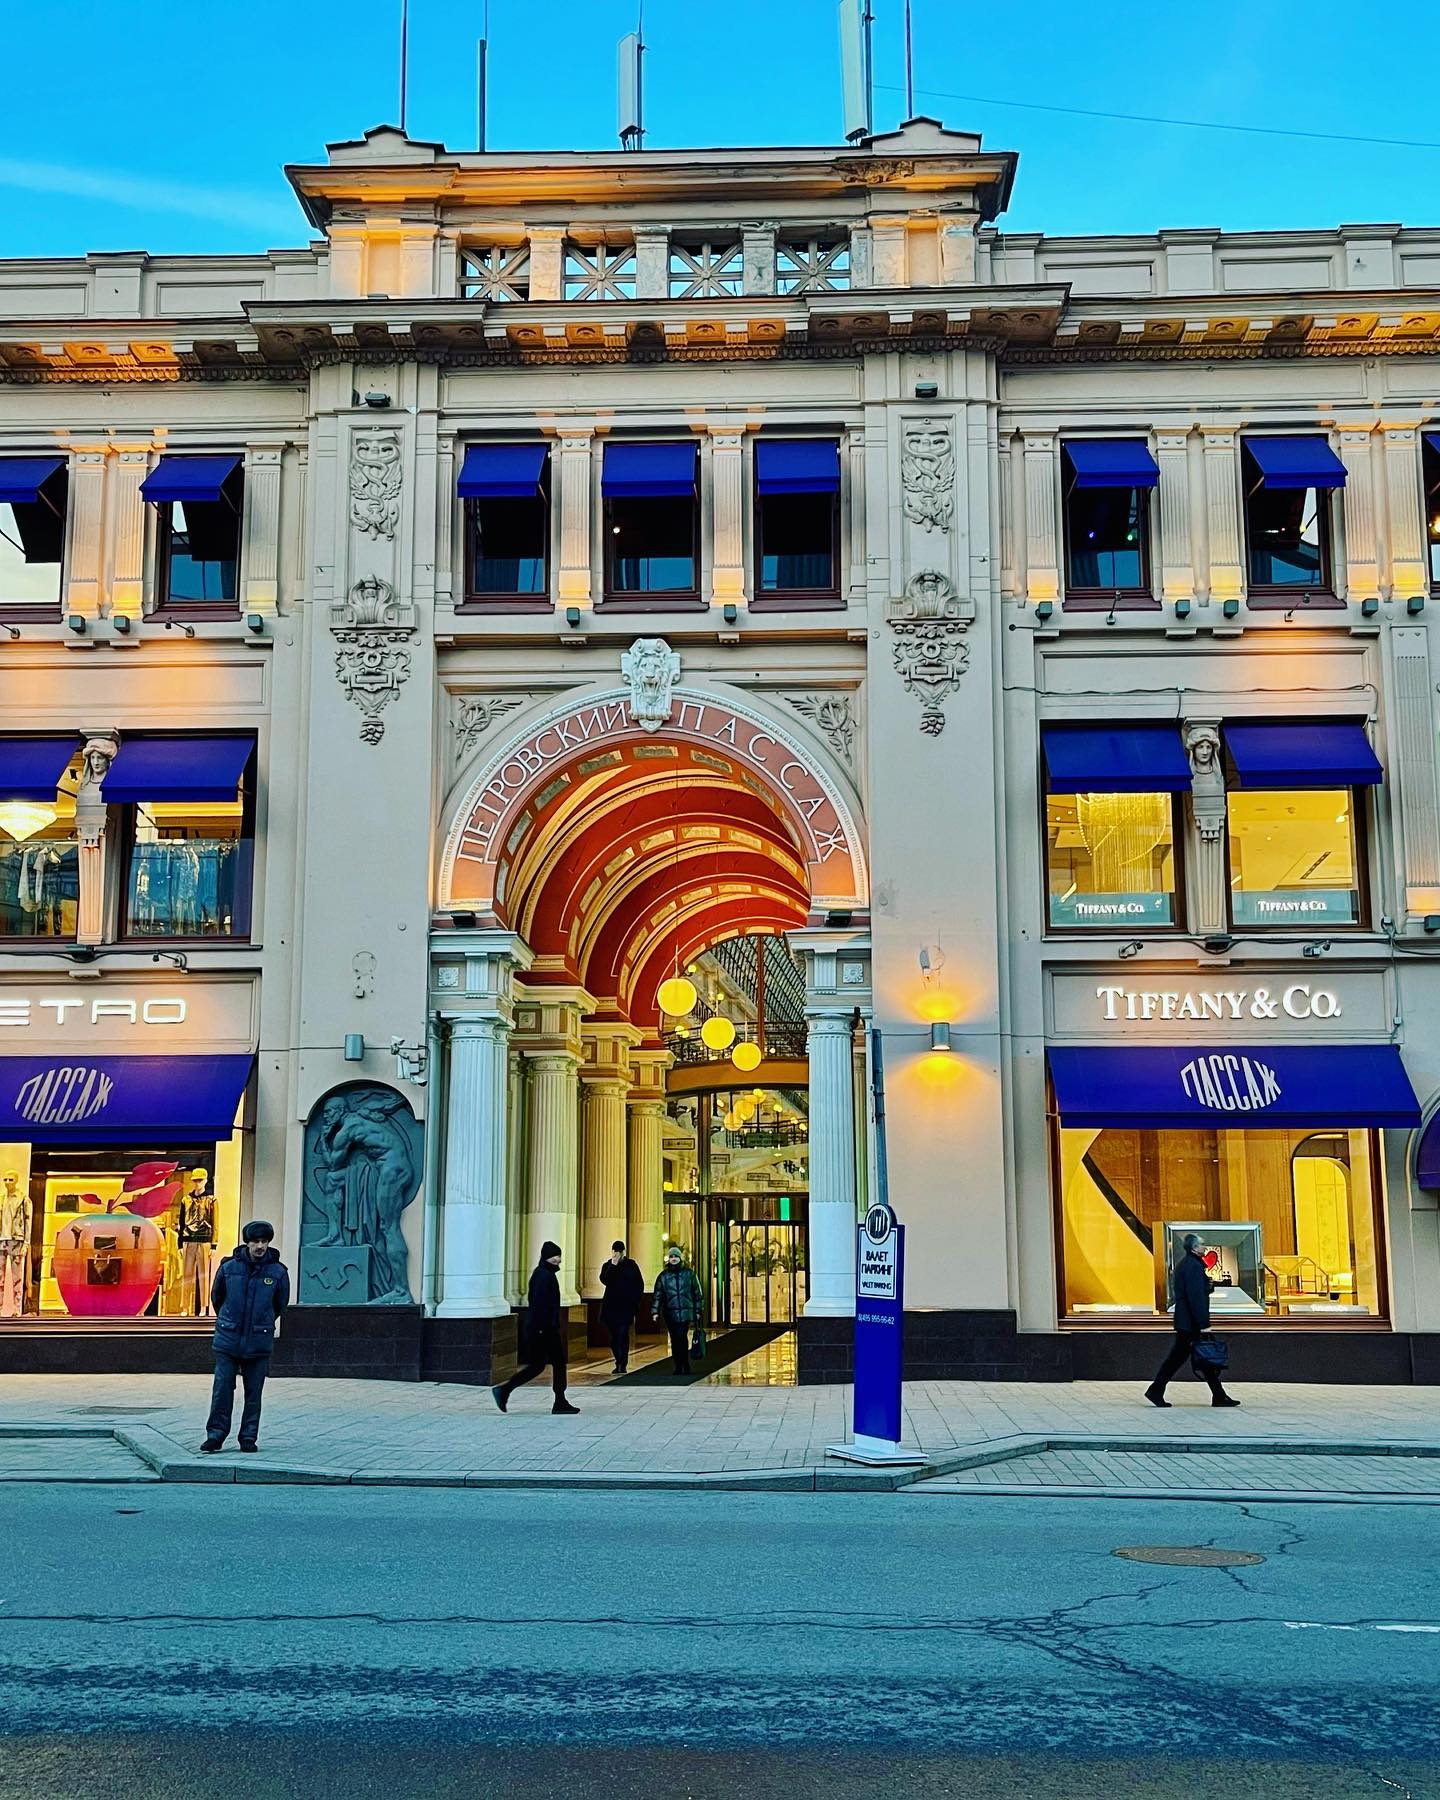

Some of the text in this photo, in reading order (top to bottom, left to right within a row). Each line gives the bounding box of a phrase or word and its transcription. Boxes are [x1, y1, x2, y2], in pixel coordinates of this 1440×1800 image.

[457, 701, 849, 863] ПЕТРОВСКИЙ ПАССАЖ
[15, 1067, 113, 1123] ПАССАЖ
[1180, 1054, 1281, 1111] ПАССАЖ
[861, 1263, 893, 1276] ПАРКИНГ
[866, 1250, 888, 1262] ВАЛЕТ
